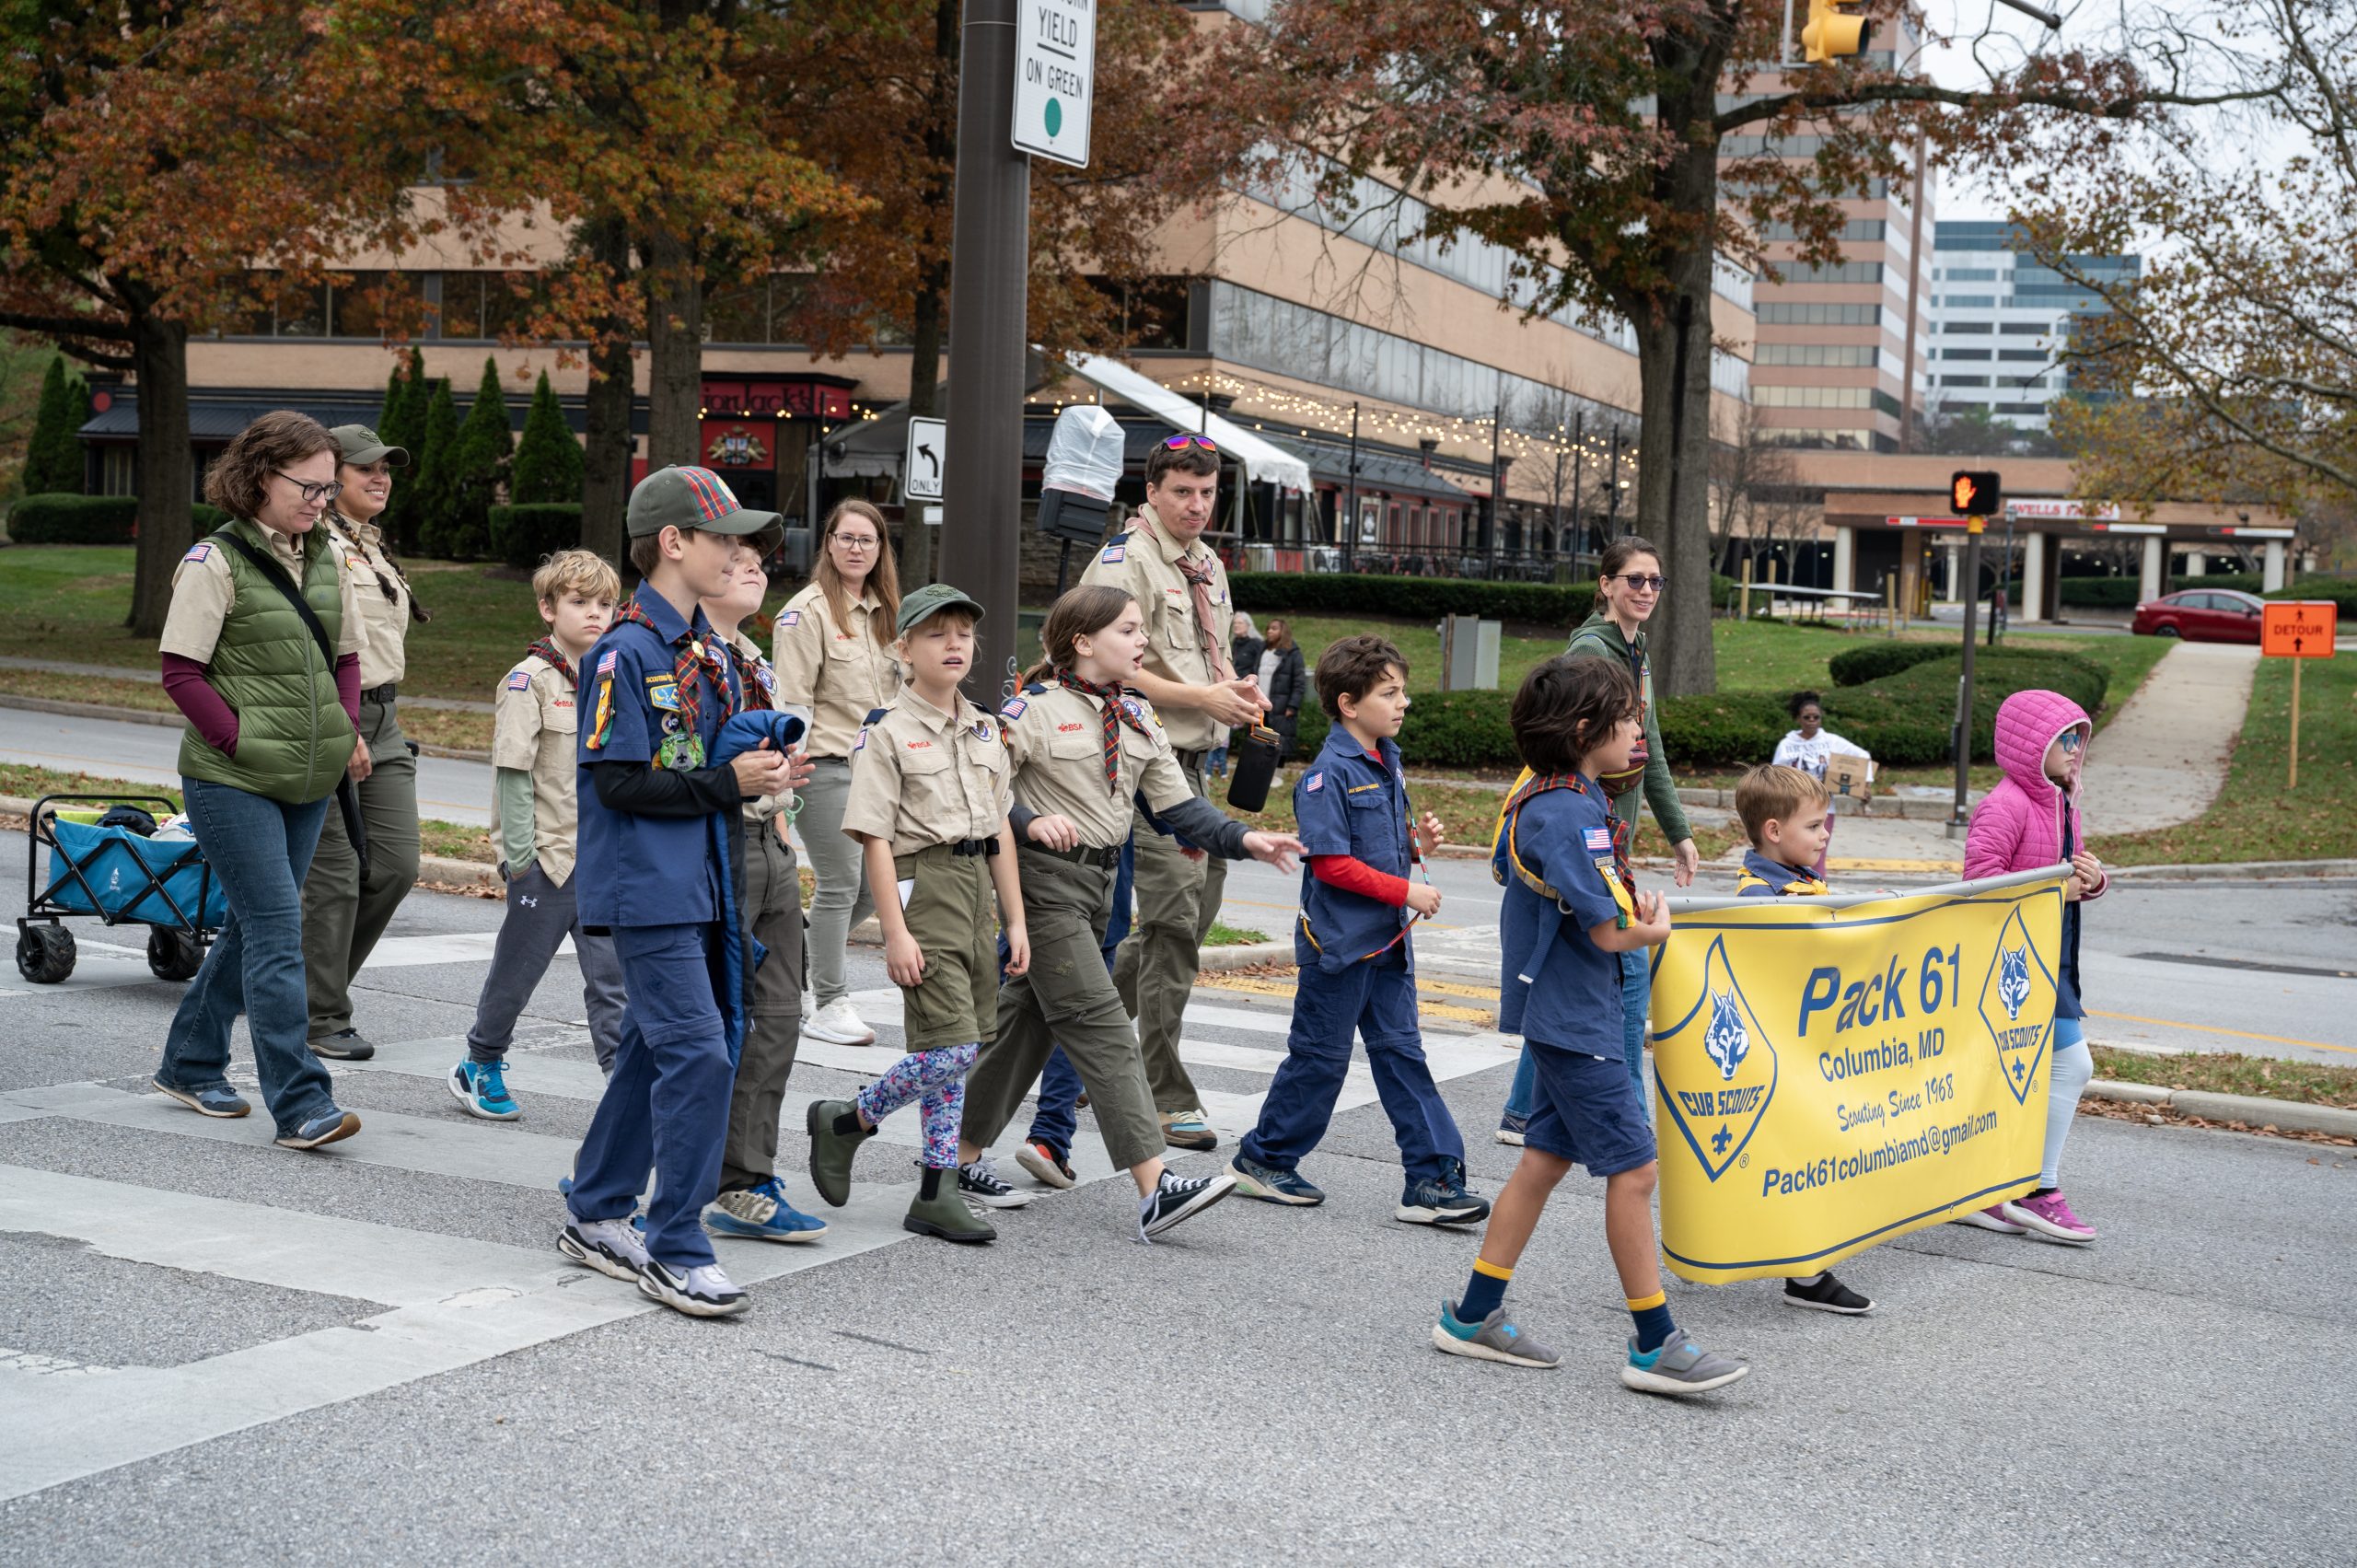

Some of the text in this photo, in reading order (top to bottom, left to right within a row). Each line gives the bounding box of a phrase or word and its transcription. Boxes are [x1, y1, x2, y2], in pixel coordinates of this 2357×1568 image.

[1038, 6, 1077, 48] YIELD
[1027, 57, 1084, 99] ON GREEN
[911, 479, 940, 493] ONLY
[2012, 504, 2061, 516] WELLS
[2274, 624, 2323, 635] DETOUR
[1068, 723, 1084, 731] BSA
[1798, 943, 1960, 1038] Pack 61
[1819, 1028, 1945, 1082] Columbia, MD
[1998, 1024, 2042, 1051] CUB SCOUTS
[1678, 1085, 1765, 1116] CUB SCOUTS
[1837, 1073, 1953, 1132] Scouting Since 1968
[1762, 1108, 1997, 1197] Pack61columbiamd@gmail.com
